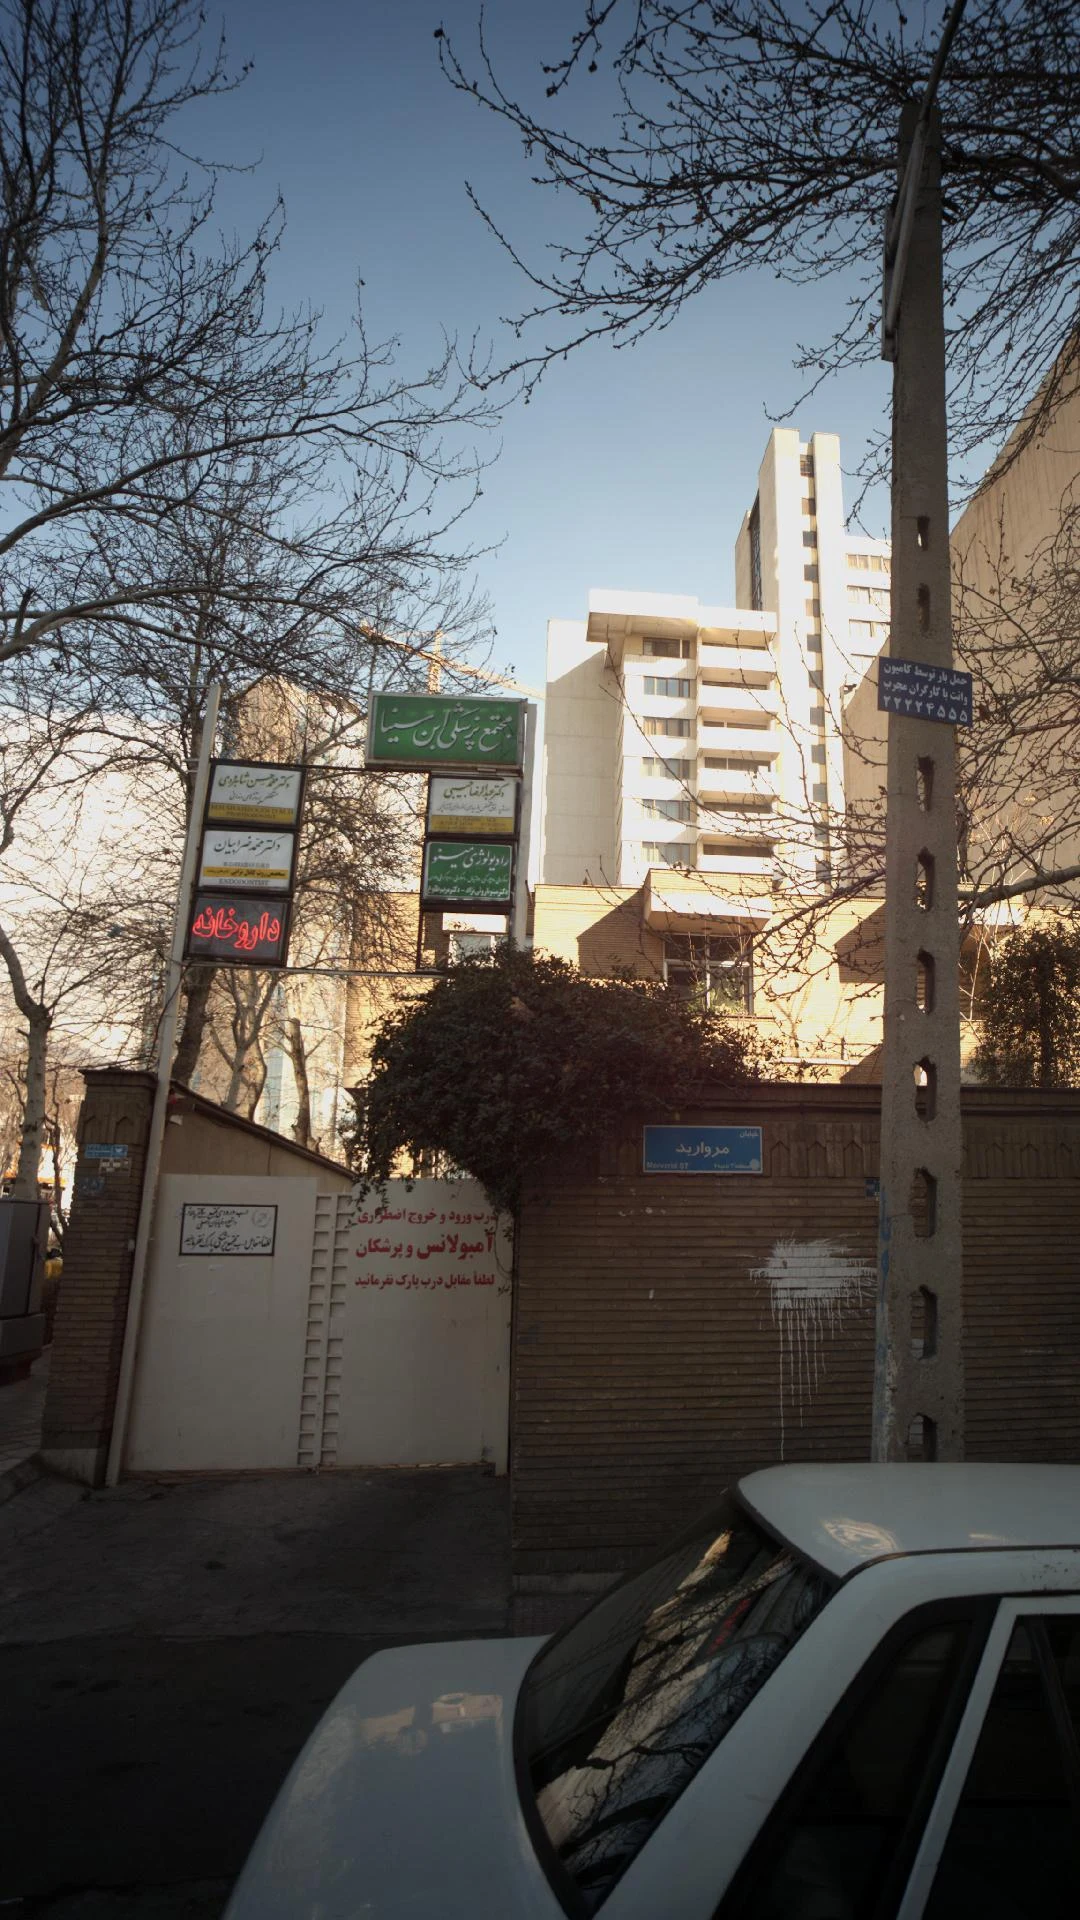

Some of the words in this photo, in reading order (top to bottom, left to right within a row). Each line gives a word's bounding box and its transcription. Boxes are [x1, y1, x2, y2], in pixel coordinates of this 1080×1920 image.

[883, 663, 912, 675] کامیون
[914, 665, 936, 682] توسط
[938, 671, 948, 683] بار
[883, 680, 908, 692] مجرب
[949, 673, 968, 686] حمل
[908, 682, 941, 698] کارگران
[942, 687, 949, 699] با
[949, 690, 968, 706] وانت
[381, 707, 435, 744] سینا
[412, 709, 451, 750] ابن
[437, 702, 481, 751] پزشکی
[478, 715, 513, 752] مجتمع
[272, 774, 295, 791] دکتر
[489, 783, 511, 801] دکتر
[247, 837, 264, 852] محمد
[255, 834, 288, 857] دکتر
[431, 847, 474, 869] مینو
[462, 849, 510, 871] رادیولوژی
[192, 906, 281, 951] داروخانه
[739, 1129, 760, 1138] خیابان
[675, 1142, 730, 1159] مروارید
[408, 1208, 437, 1224] خروج
[439, 1213, 446, 1224] و
[448, 1210, 472, 1224] ورود
[405, 1244, 414, 1258] و
[416, 1231, 495, 1260] آمبولانس
[395, 1273, 419, 1290] پارک
[420, 1275, 443, 1290] درب
[443, 1273, 471, 1290] مقابل
